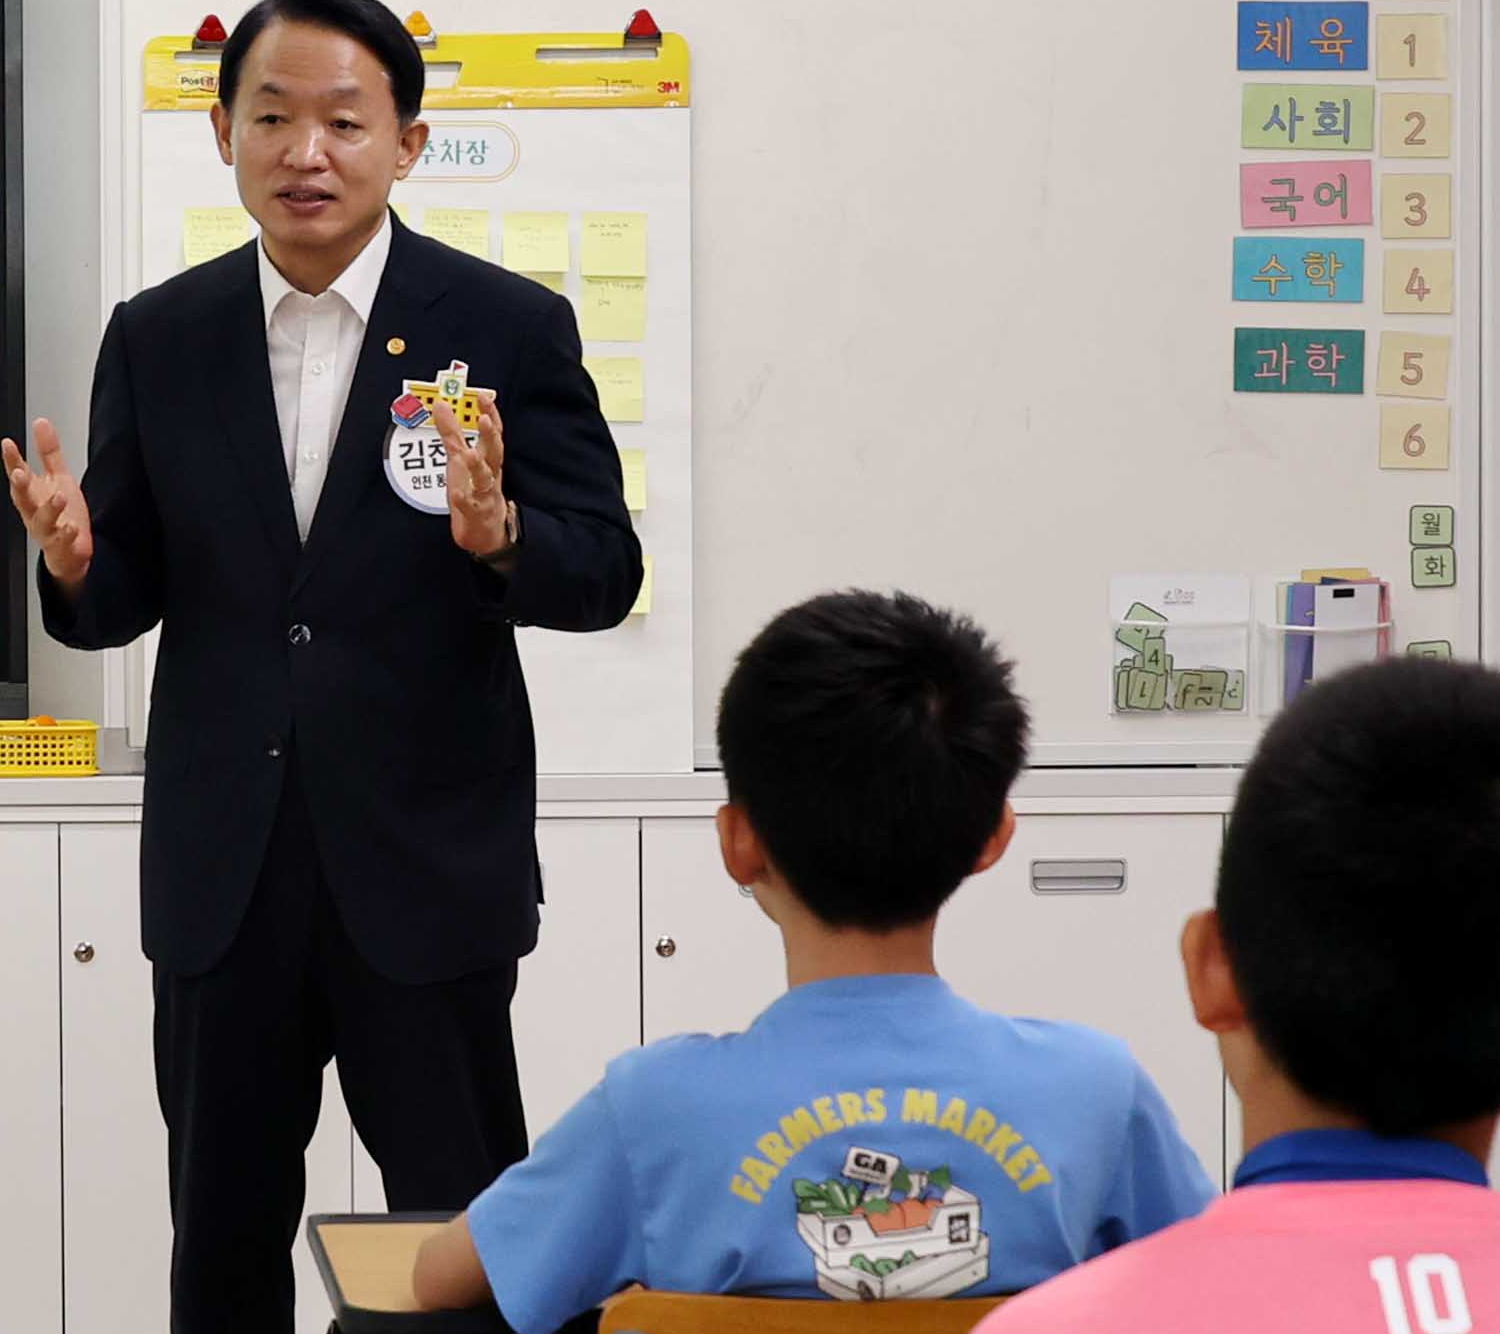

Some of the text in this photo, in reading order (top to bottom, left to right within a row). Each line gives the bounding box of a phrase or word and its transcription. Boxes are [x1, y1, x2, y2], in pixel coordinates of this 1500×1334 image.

[1254, 17, 1417, 68] 체육 1
[656, 80, 681, 94] 3M
[1262, 97, 1428, 147] 사회 2
[1261, 173, 1428, 227] 국어 3
[1251, 250, 1431, 301] 수학 4
[1253, 341, 1424, 388] 과학 5
[1402, 423, 1427, 457] 6
[729, 1087, 1055, 1205] FARMERS MARKET
